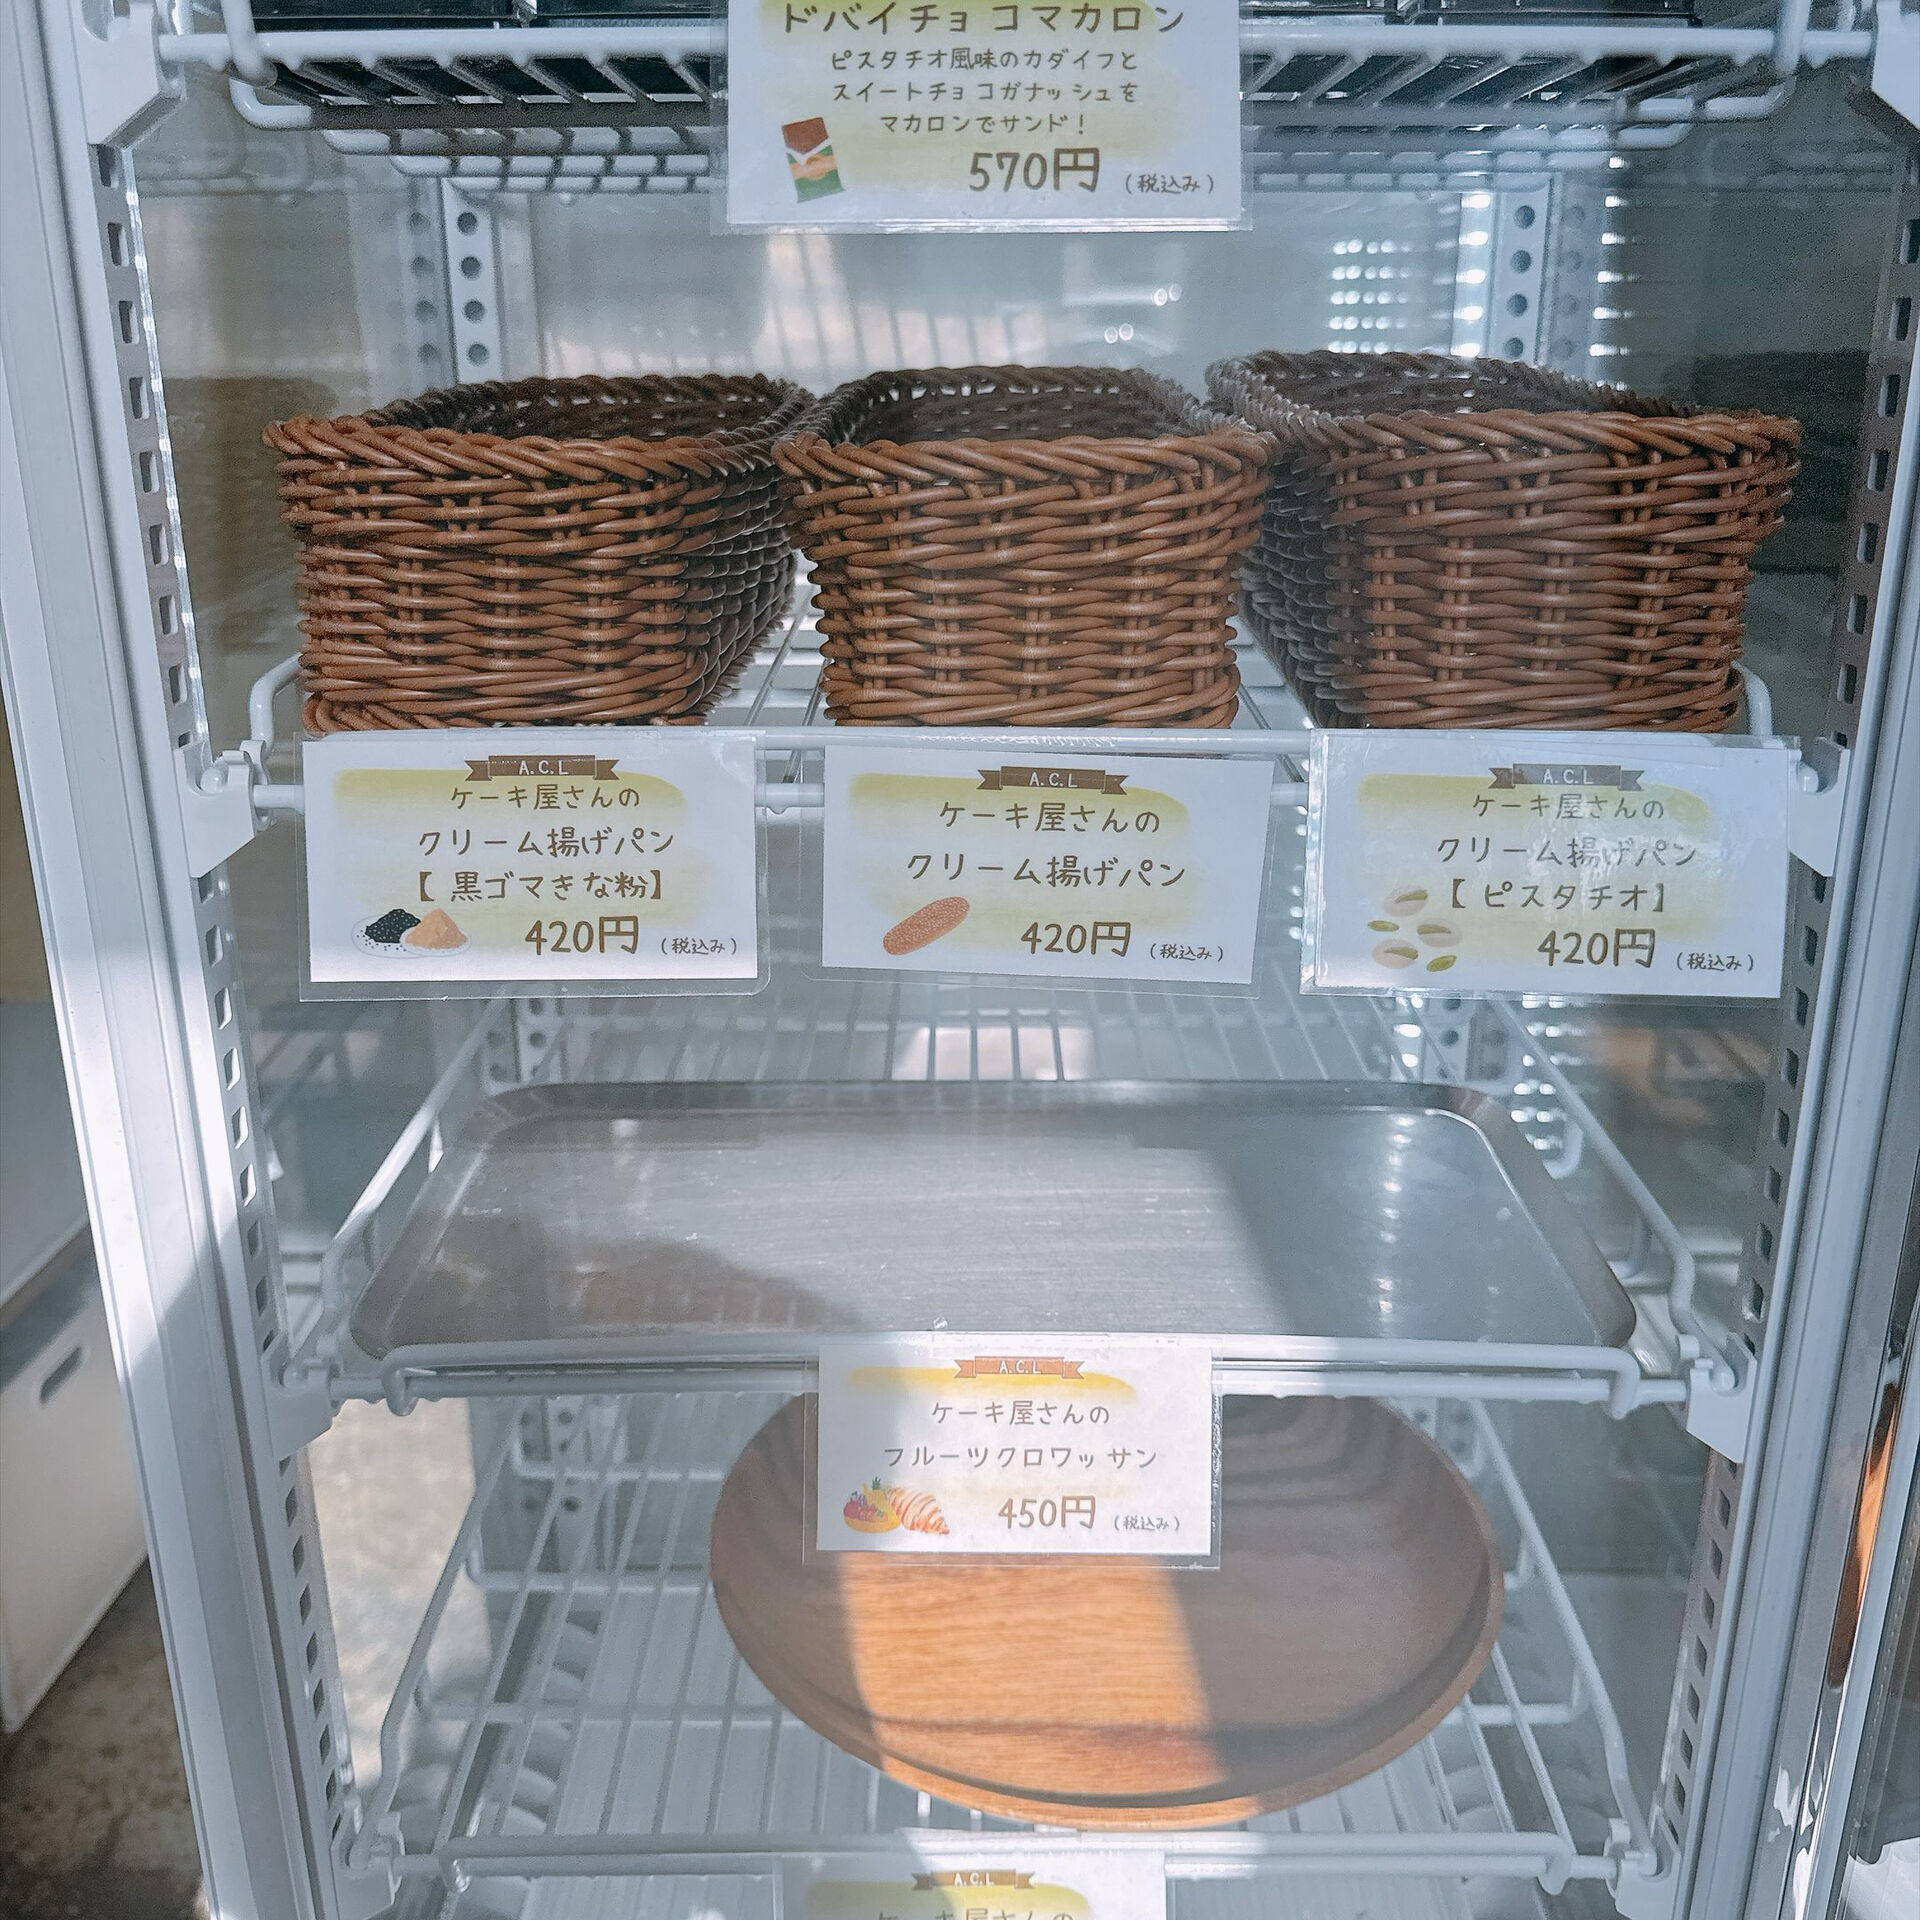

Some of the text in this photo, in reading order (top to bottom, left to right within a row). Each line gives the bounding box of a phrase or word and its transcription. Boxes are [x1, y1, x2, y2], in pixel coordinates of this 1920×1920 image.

[784, 1, 1185, 34] ドバイチョコマカロン
[830, 47, 1139, 71] ピスタチオ風味のカダイフと
[832, 82, 1137, 102] スイートチョコガナッシュを
[968, 147, 1101, 193] 570円
[518, 760, 569, 775] A.C.L
[1029, 772, 1077, 788] A.C.L
[1543, 768, 1594, 785] A.C.L
[450, 783, 641, 810] ケーキ屋さんの
[1472, 793, 1664, 820] ケーキ屋さんの
[939, 801, 1160, 833] ケーキ屋さんの
[417, 826, 675, 858] クリーム揚げパン
[1435, 837, 1697, 868] クリーム揚げパン
[906, 853, 1186, 888] クリーム揚げパン
[524, 915, 639, 955] 420円
[1020, 921, 1131, 957] 420円
[1537, 927, 1656, 969] 420円
[999, 1359, 1042, 1374] A.C.L
[931, 1400, 1111, 1425] ケーキ屋さんの
[883, 1445, 1158, 1469] フルーツクロワッサン
[997, 1495, 1096, 1530] 450円
